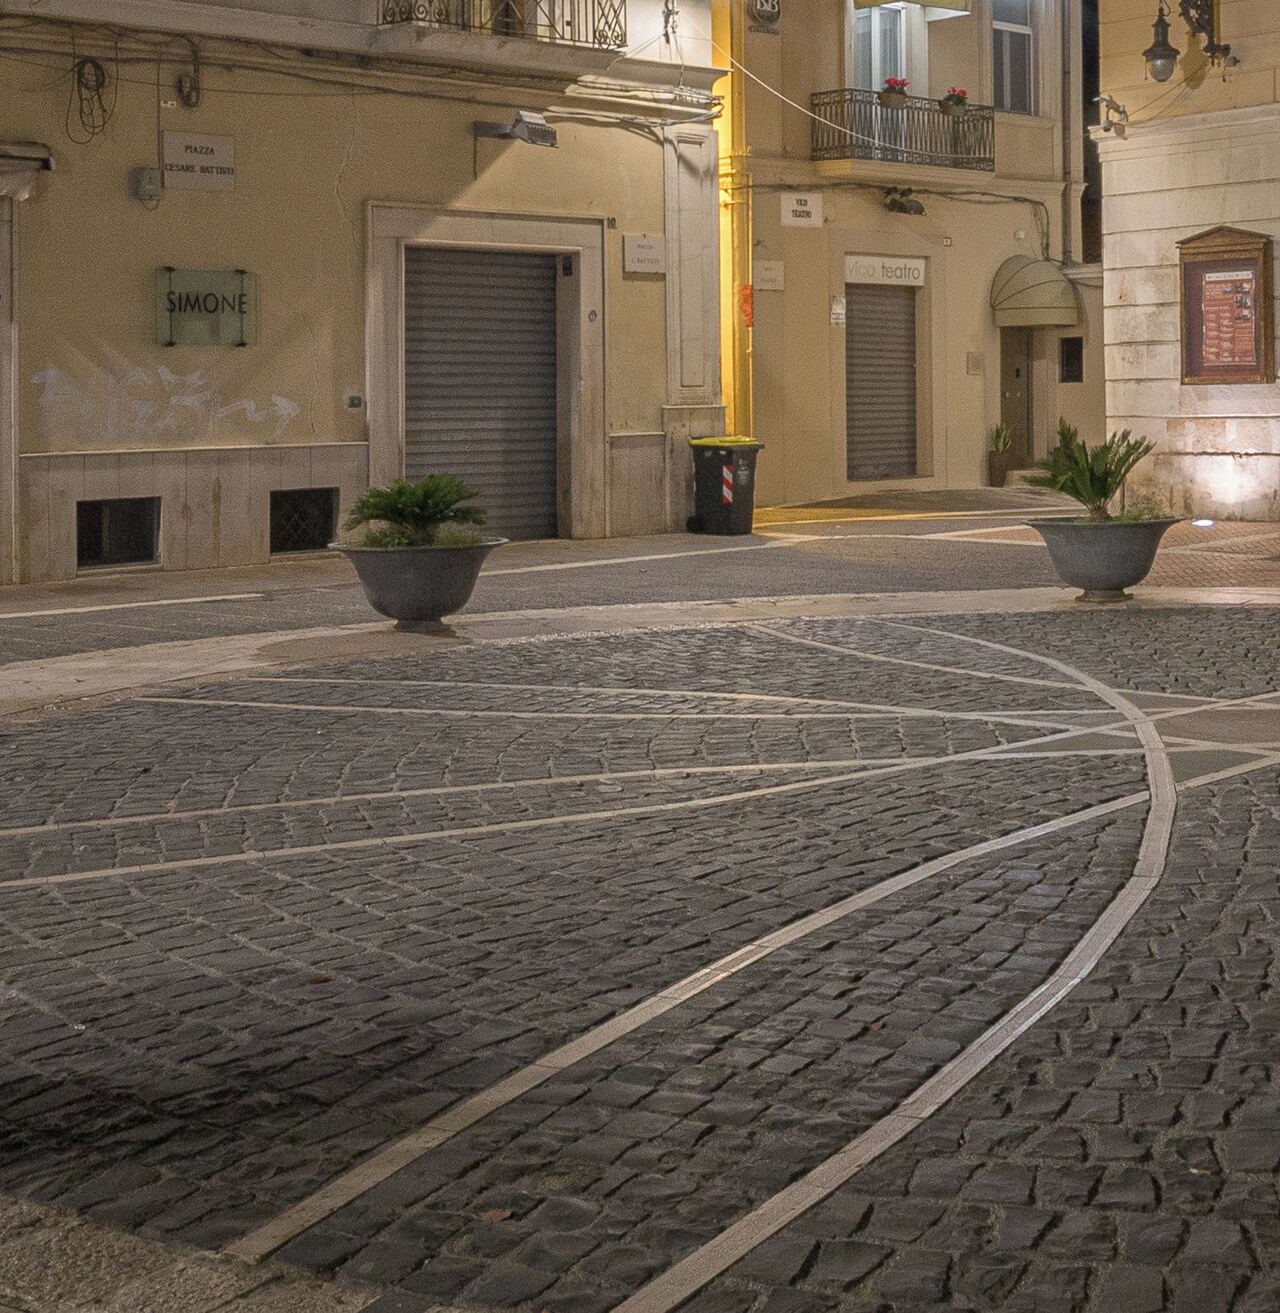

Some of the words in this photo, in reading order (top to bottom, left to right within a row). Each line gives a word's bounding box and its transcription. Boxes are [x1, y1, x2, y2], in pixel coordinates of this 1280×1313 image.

[184, 145, 216, 155] PIAZZA
[164, 163, 197, 174] CESARE
[791, 209, 812, 218] TEATRO
[846, 262, 876, 278] vico
[881, 262, 921, 280] teatro
[166, 291, 247, 314] SIMONE
